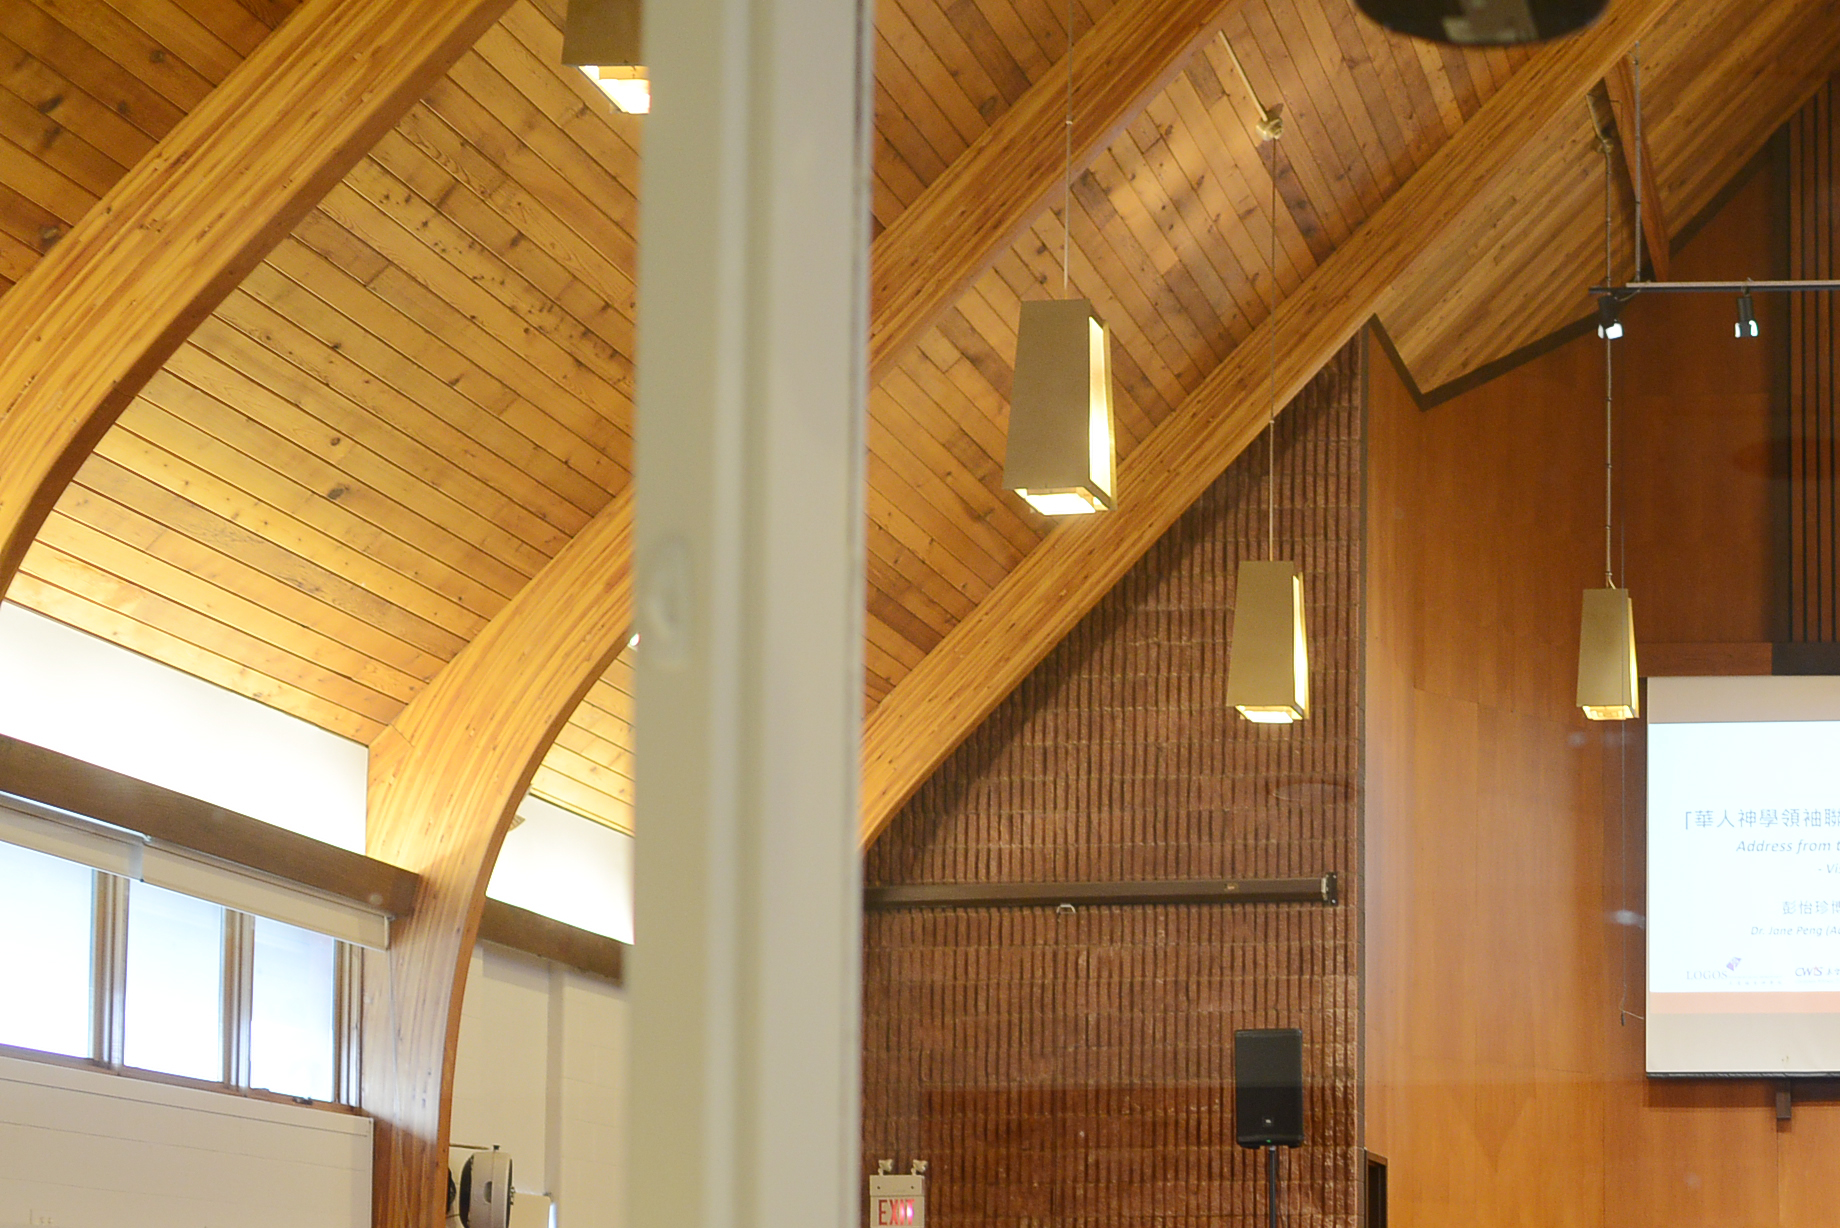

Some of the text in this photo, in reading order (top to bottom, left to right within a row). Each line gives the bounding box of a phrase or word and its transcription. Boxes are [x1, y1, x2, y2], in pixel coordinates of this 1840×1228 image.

[1735, 839, 1793, 853] Address
[1795, 838, 1831, 855] from
[1750, 926, 1765, 936] Dr.
[1768, 926, 1793, 936] Jane
[1796, 926, 1823, 938] Peng
[1686, 970, 1728, 980] LOGOS
[878, 1199, 915, 1226] EXIT
